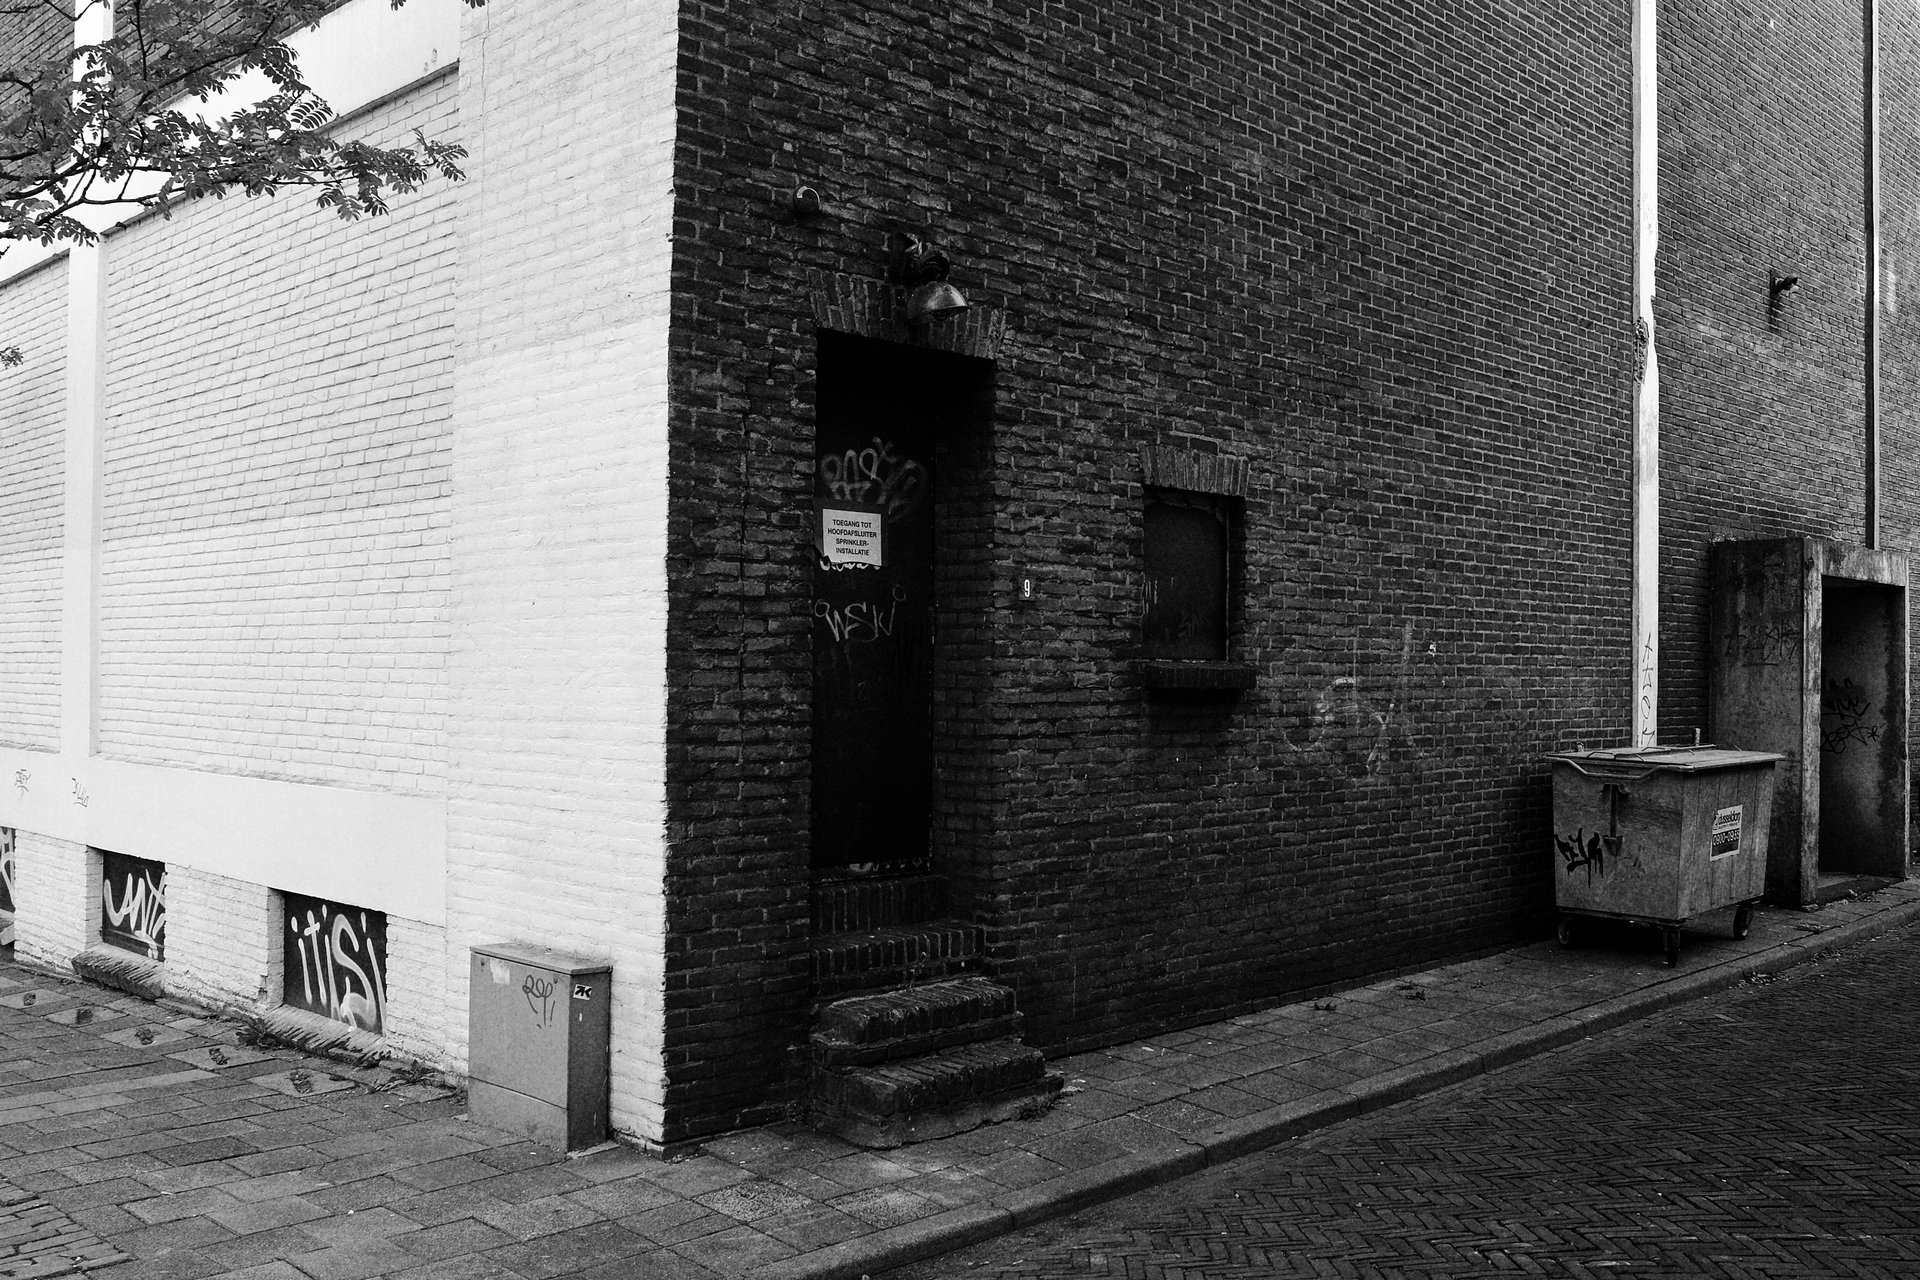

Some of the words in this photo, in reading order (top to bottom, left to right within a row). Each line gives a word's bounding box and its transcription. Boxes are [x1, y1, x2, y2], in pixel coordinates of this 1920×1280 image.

[832, 519, 860, 528] TOEGANG
[861, 521, 872, 529] TOT
[827, 527, 877, 538] HOOFDAFSLUITER
[835, 537, 869, 547] SPRINKLER-
[835, 547, 869, 556] INSTALLATIE
[1022, 579, 1031, 598] 9
